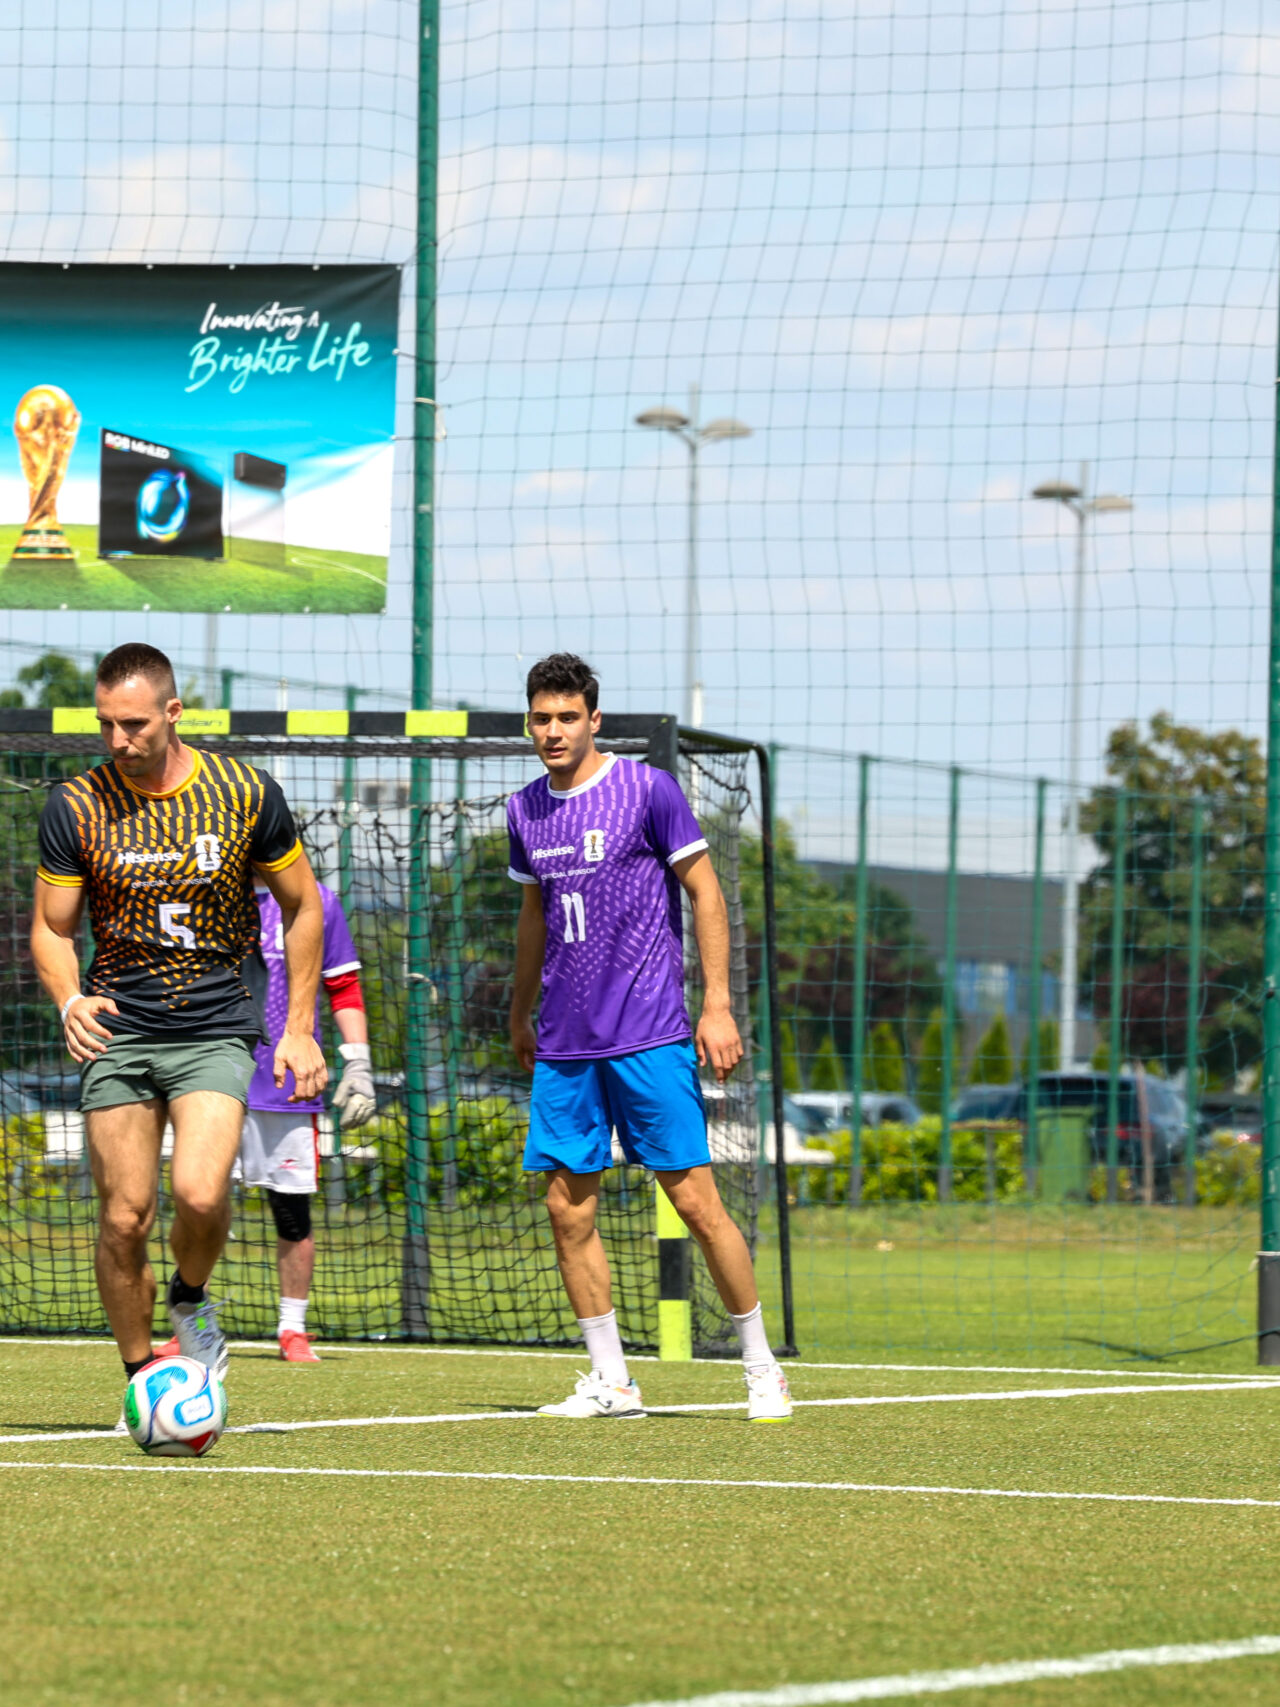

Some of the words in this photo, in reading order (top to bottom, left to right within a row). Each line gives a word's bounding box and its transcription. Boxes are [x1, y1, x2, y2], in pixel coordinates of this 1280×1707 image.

[200, 302, 305, 341] Innovating
[184, 336, 302, 394] Brighter
[307, 321, 373, 382] Life
[117, 851, 184, 866] Hisense
[531, 845, 576, 860] Hisense
[158, 903, 197, 949] 5
[560, 892, 586, 943] 11
